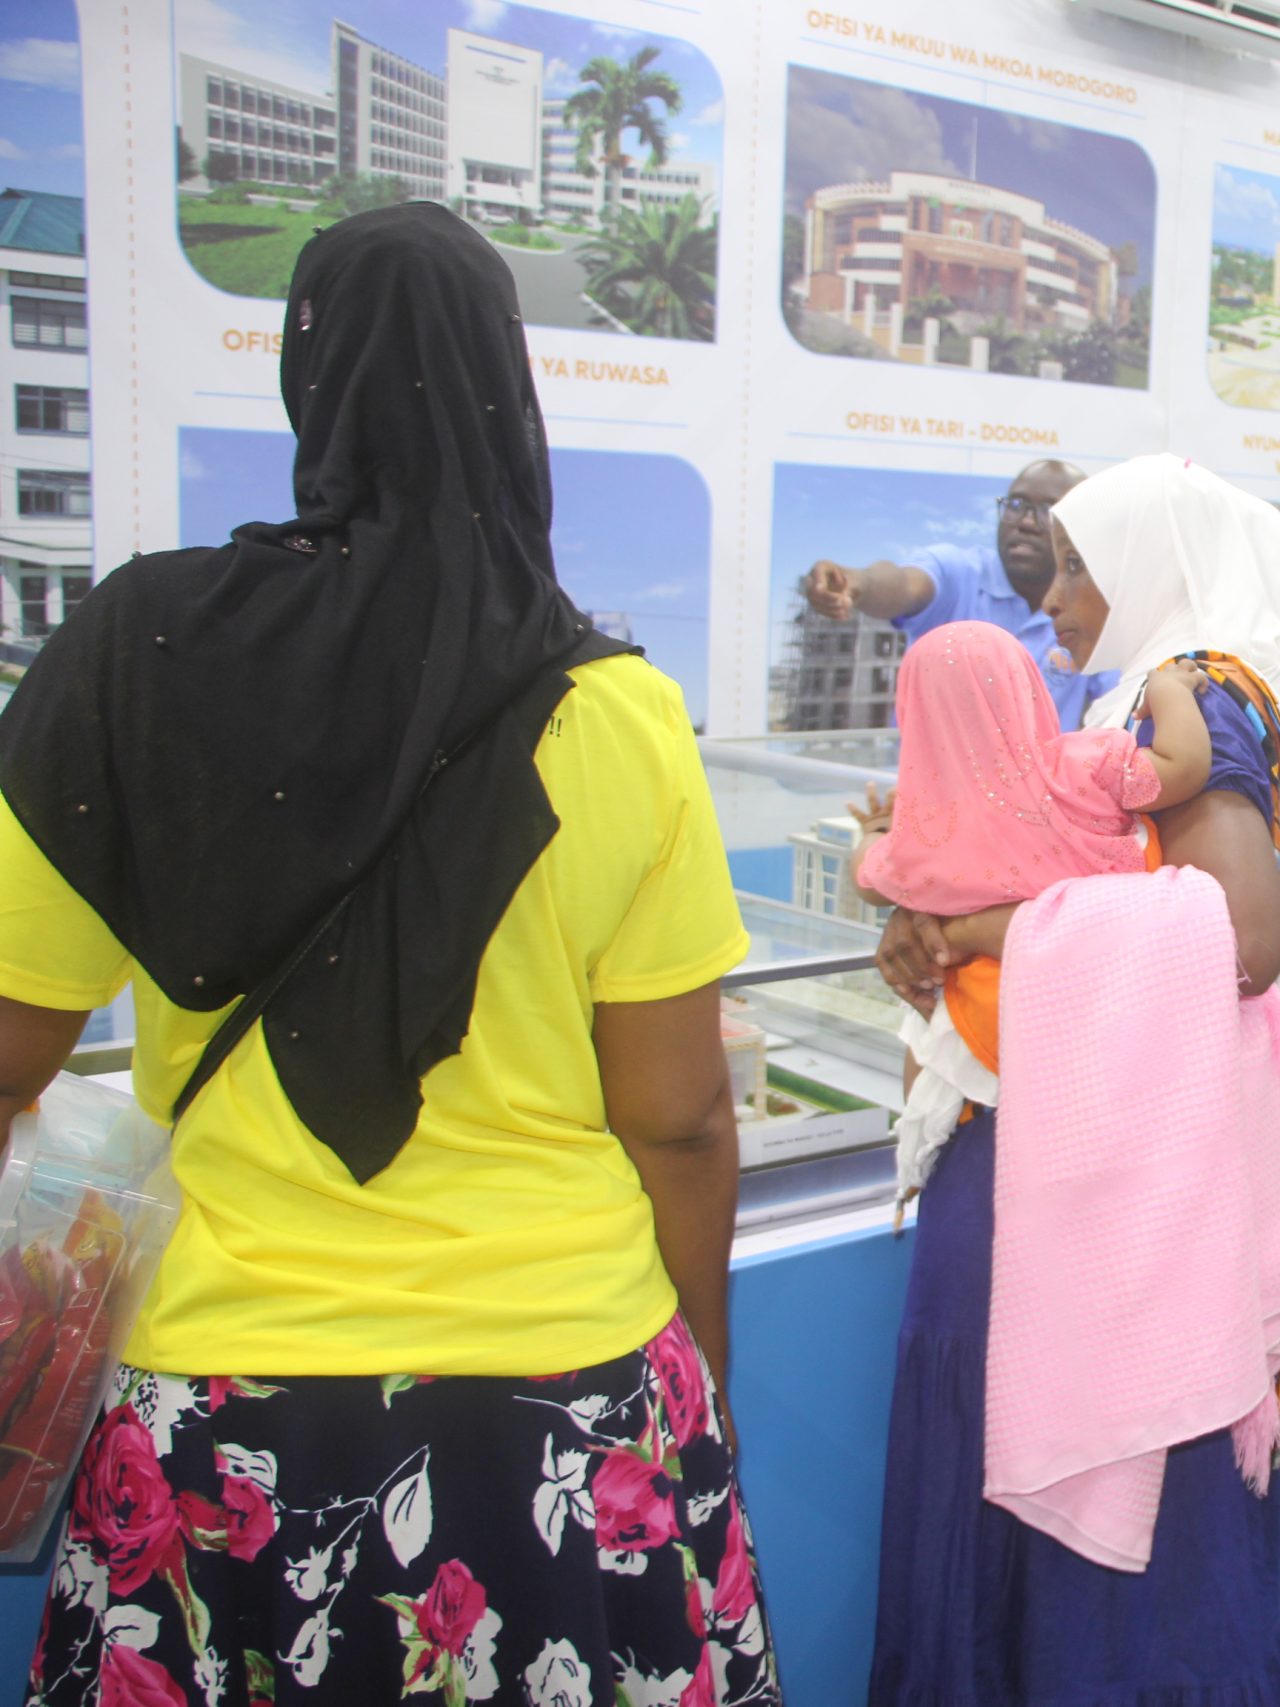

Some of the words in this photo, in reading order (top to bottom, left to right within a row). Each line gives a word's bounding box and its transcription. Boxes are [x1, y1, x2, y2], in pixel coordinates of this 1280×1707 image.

[807, 9, 858, 37] OFISI
[863, 23, 886, 44] YA
[890, 29, 945, 58] MKUU
[949, 45, 978, 67] WA
[984, 53, 1033, 80] MKOA
[1038, 67, 1138, 104] MOROGORO
[541, 357, 569, 378] YA
[575, 359, 670, 385] RUWASA
[846, 412, 895, 433] OFISI
[900, 416, 922, 435] YA
[926, 418, 965, 439] TARI
[981, 424, 1059, 446] DODOMA
